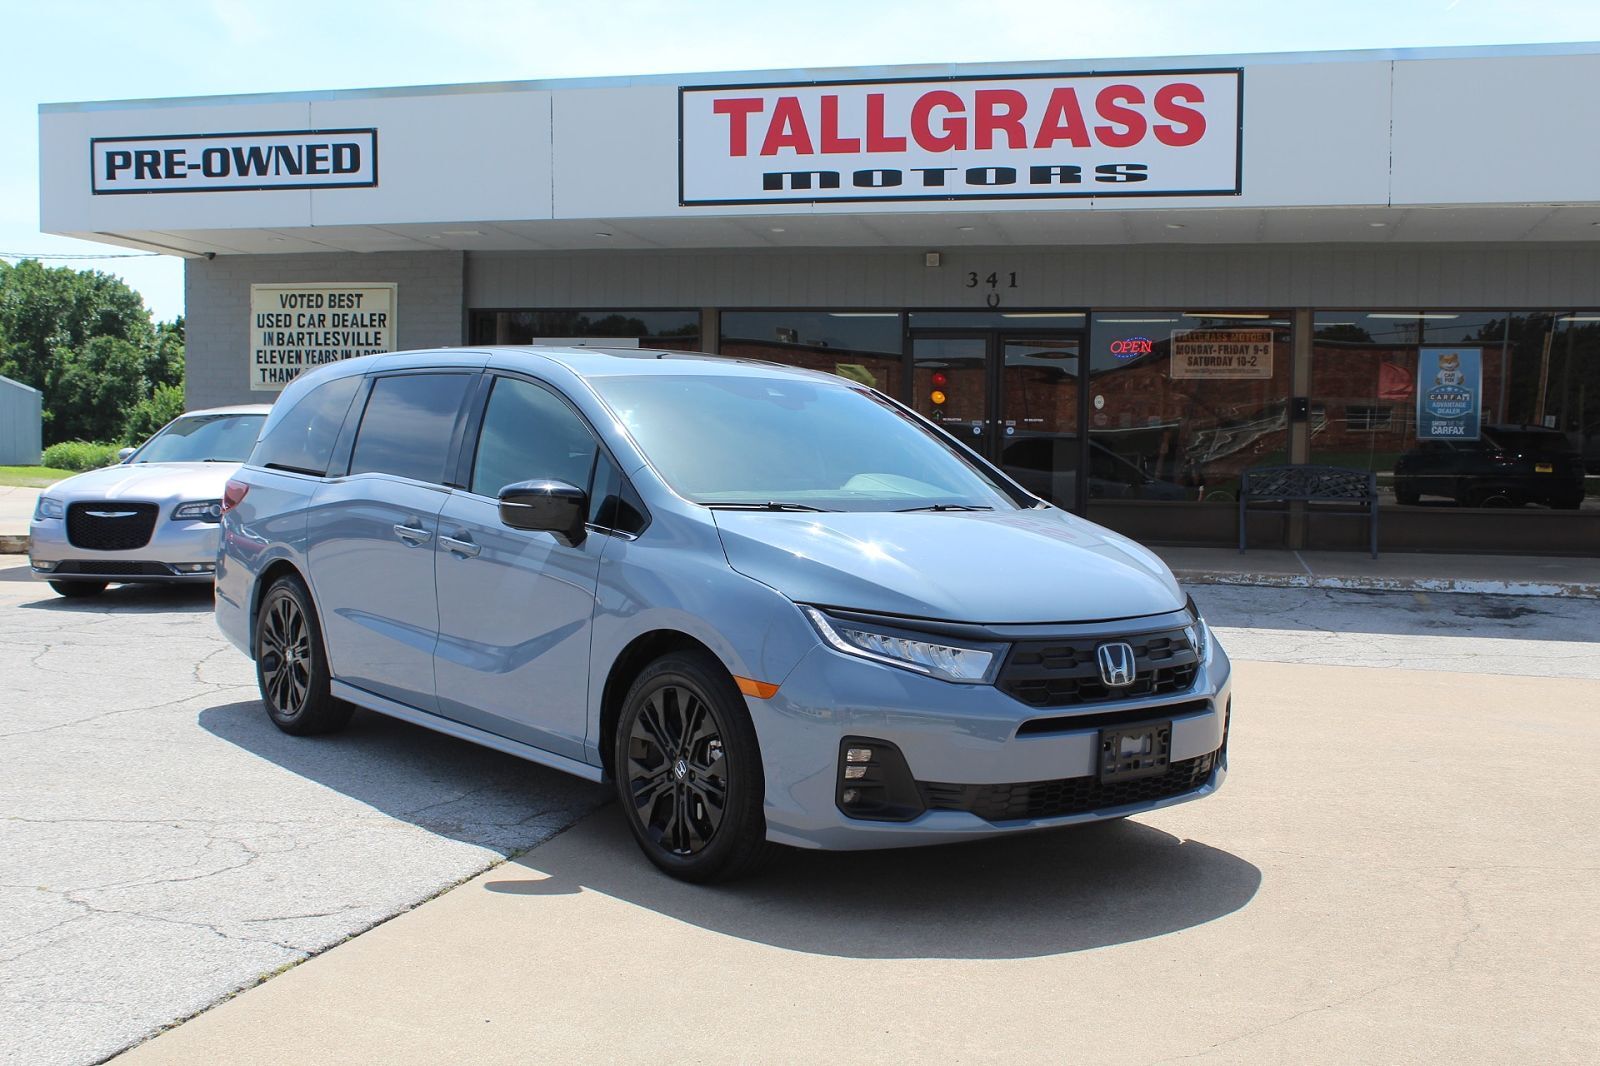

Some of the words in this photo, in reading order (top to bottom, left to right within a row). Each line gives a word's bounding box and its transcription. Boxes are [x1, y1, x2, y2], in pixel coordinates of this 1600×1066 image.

[713, 82, 1207, 157] TALLGRASS
[105, 143, 361, 180] PRE-OWNED
[762, 164, 1149, 191] MOTORS
[280, 293, 324, 308] VOTED
[328, 293, 363, 308] BEST
[257, 313, 292, 329] USED
[297, 313, 326, 328] CAR
[332, 313, 387, 328] DEALER
[276, 331, 382, 347] BARTLESVILLE
[1110, 340, 1153, 354] OPEN
[256, 350, 302, 365] ELEVEN
[305, 350, 338, 364] YEARS
[1187, 356, 1233, 367] SATURDAY
[1236, 356, 1257, 367] 10-2
[1431, 426, 1465, 435] CARFAX
